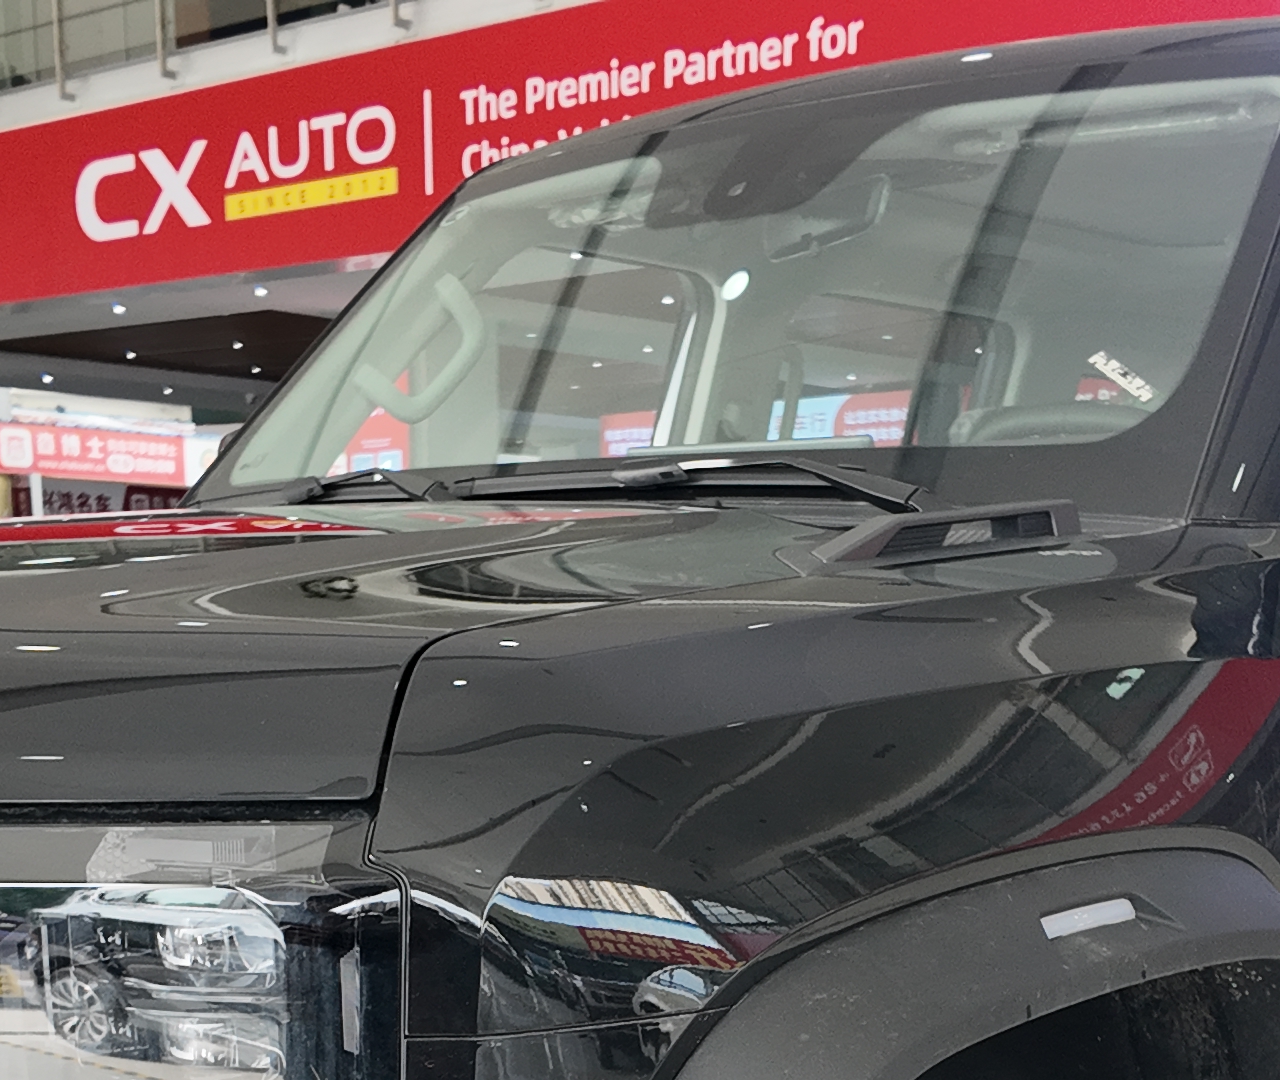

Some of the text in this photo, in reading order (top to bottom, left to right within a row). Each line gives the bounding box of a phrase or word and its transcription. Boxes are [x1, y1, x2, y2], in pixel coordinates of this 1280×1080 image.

[459, 15, 864, 126] The Premier Partner for
[74, 104, 397, 243] CX AUTO
[238, 174, 387, 215] SINCE 2012
